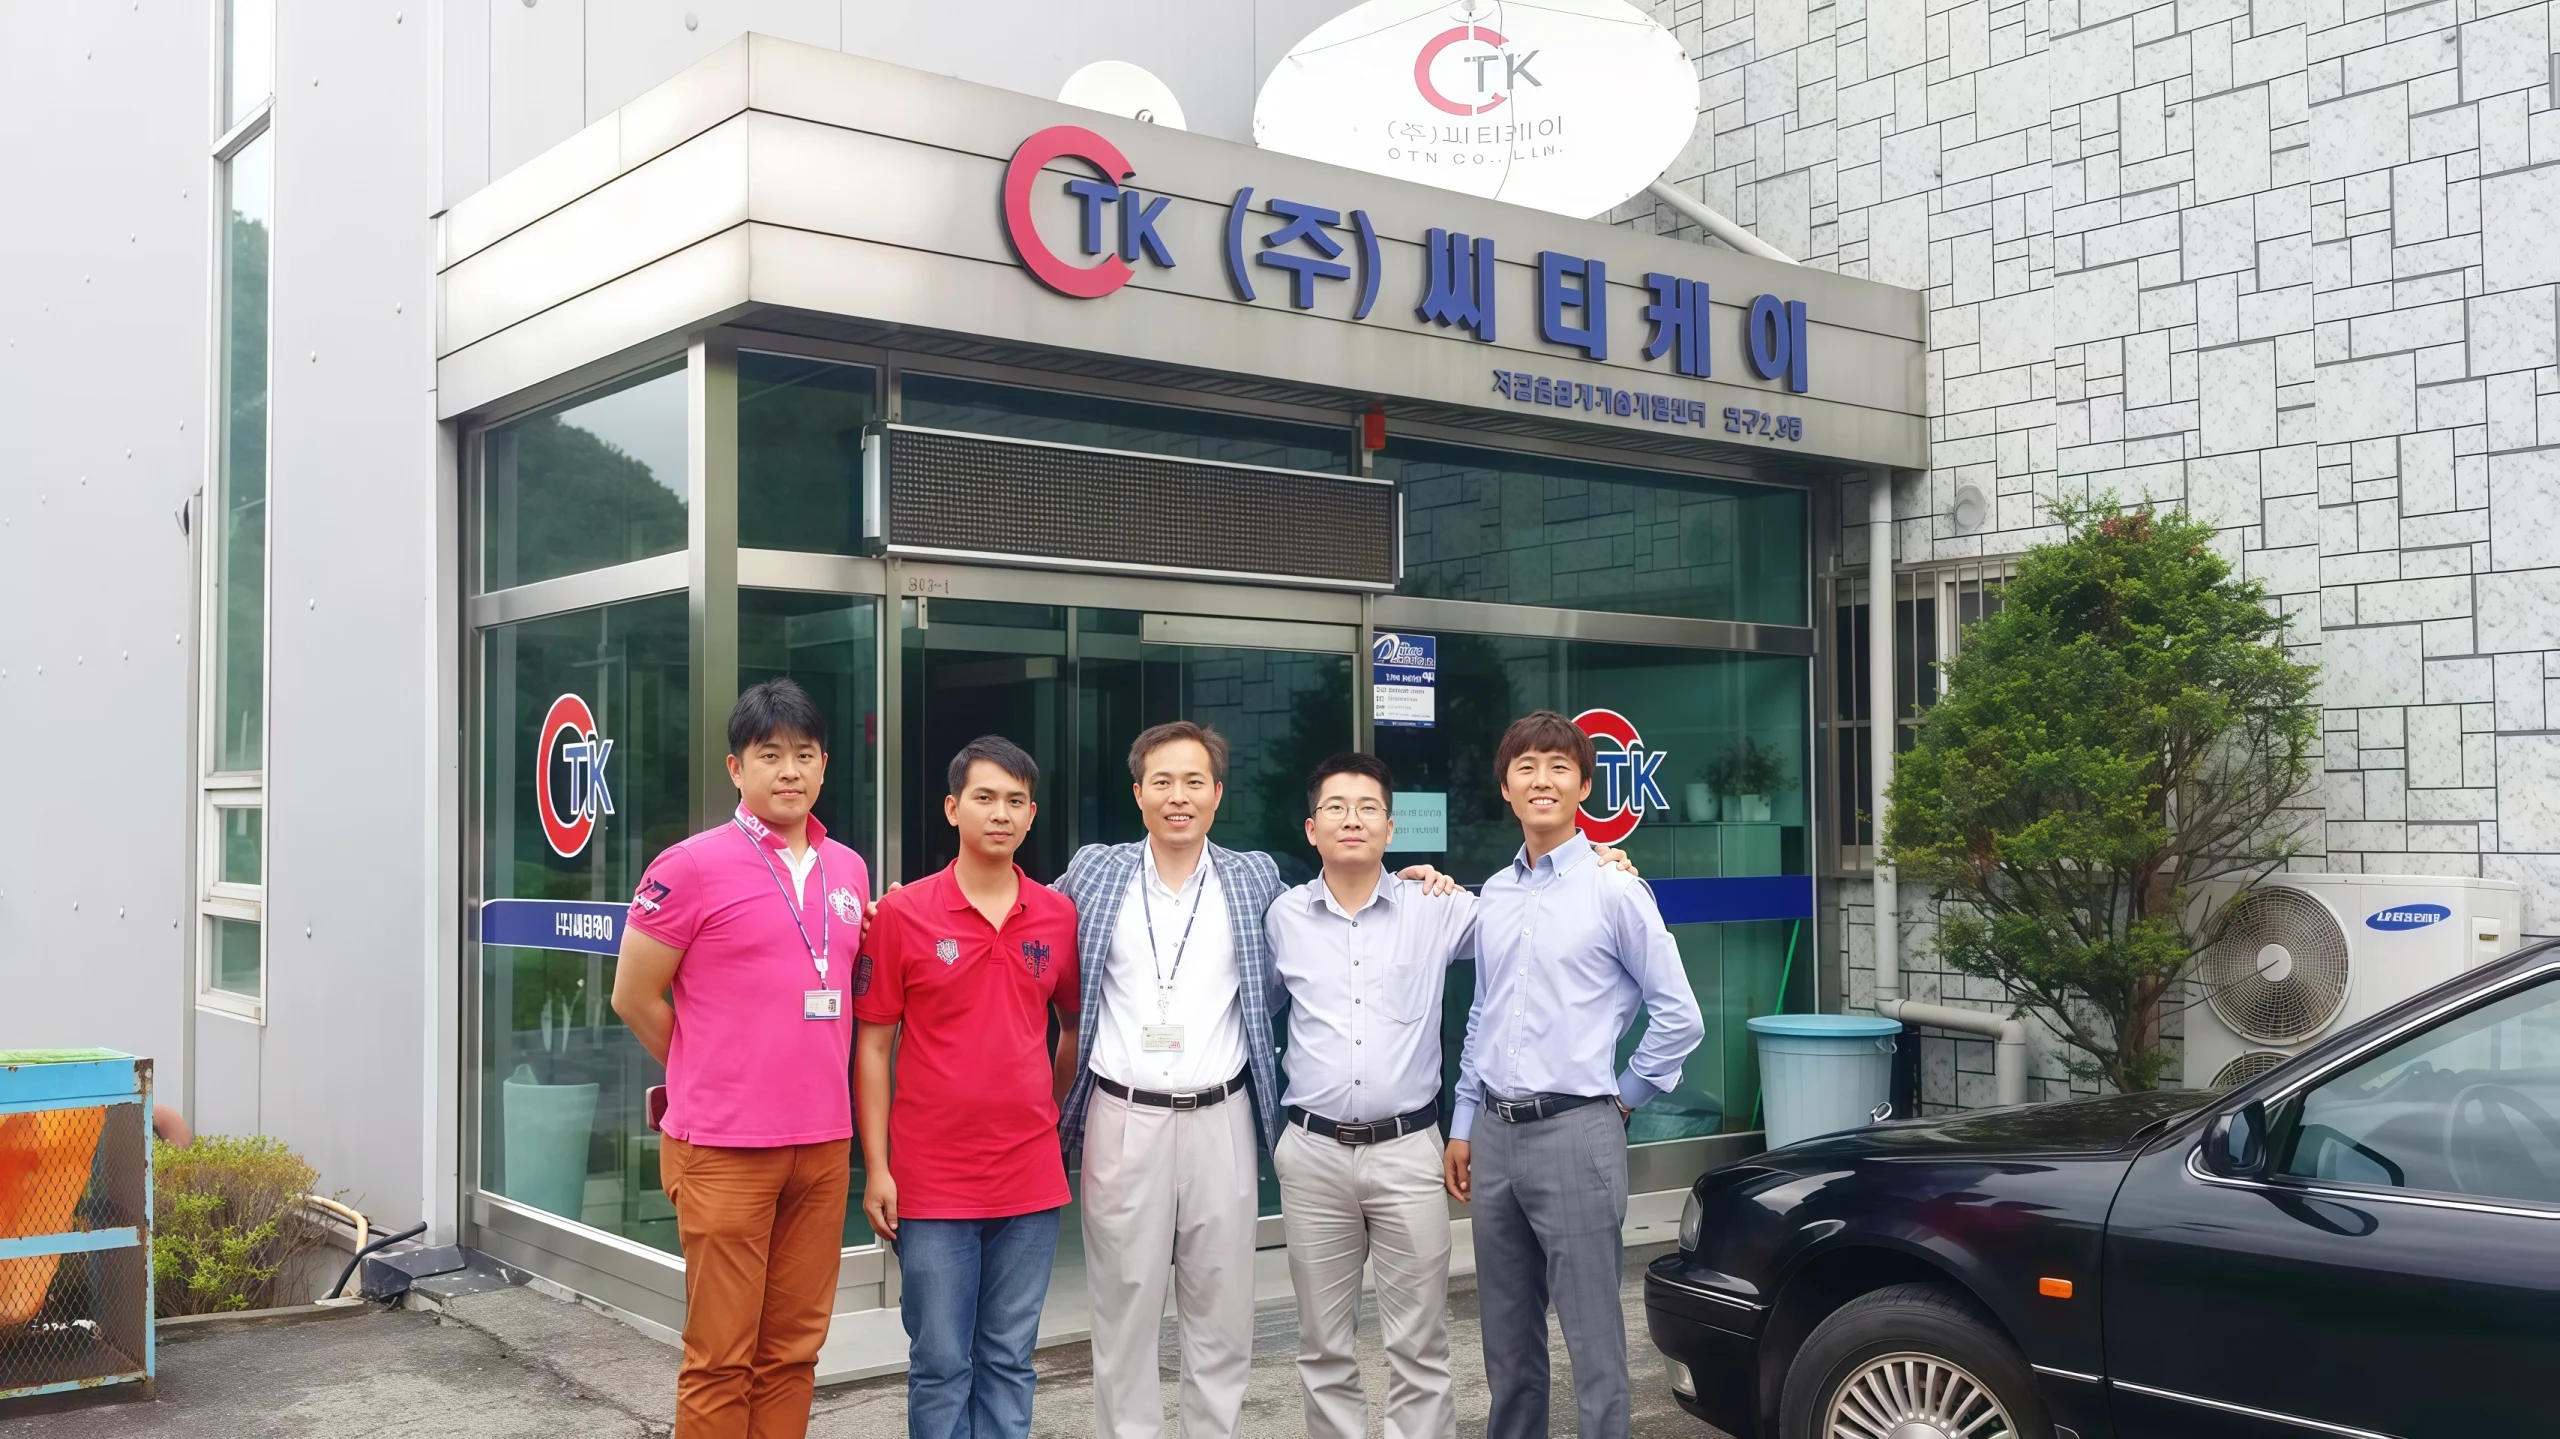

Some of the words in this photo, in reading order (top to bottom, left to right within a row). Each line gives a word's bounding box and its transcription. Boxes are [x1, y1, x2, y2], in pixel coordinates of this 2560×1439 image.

[1414, 25, 1543, 116] CTK
[1001, 125, 1176, 299] CTK
[536, 693, 615, 858] CTK
[1571, 708, 1670, 846] CTK
